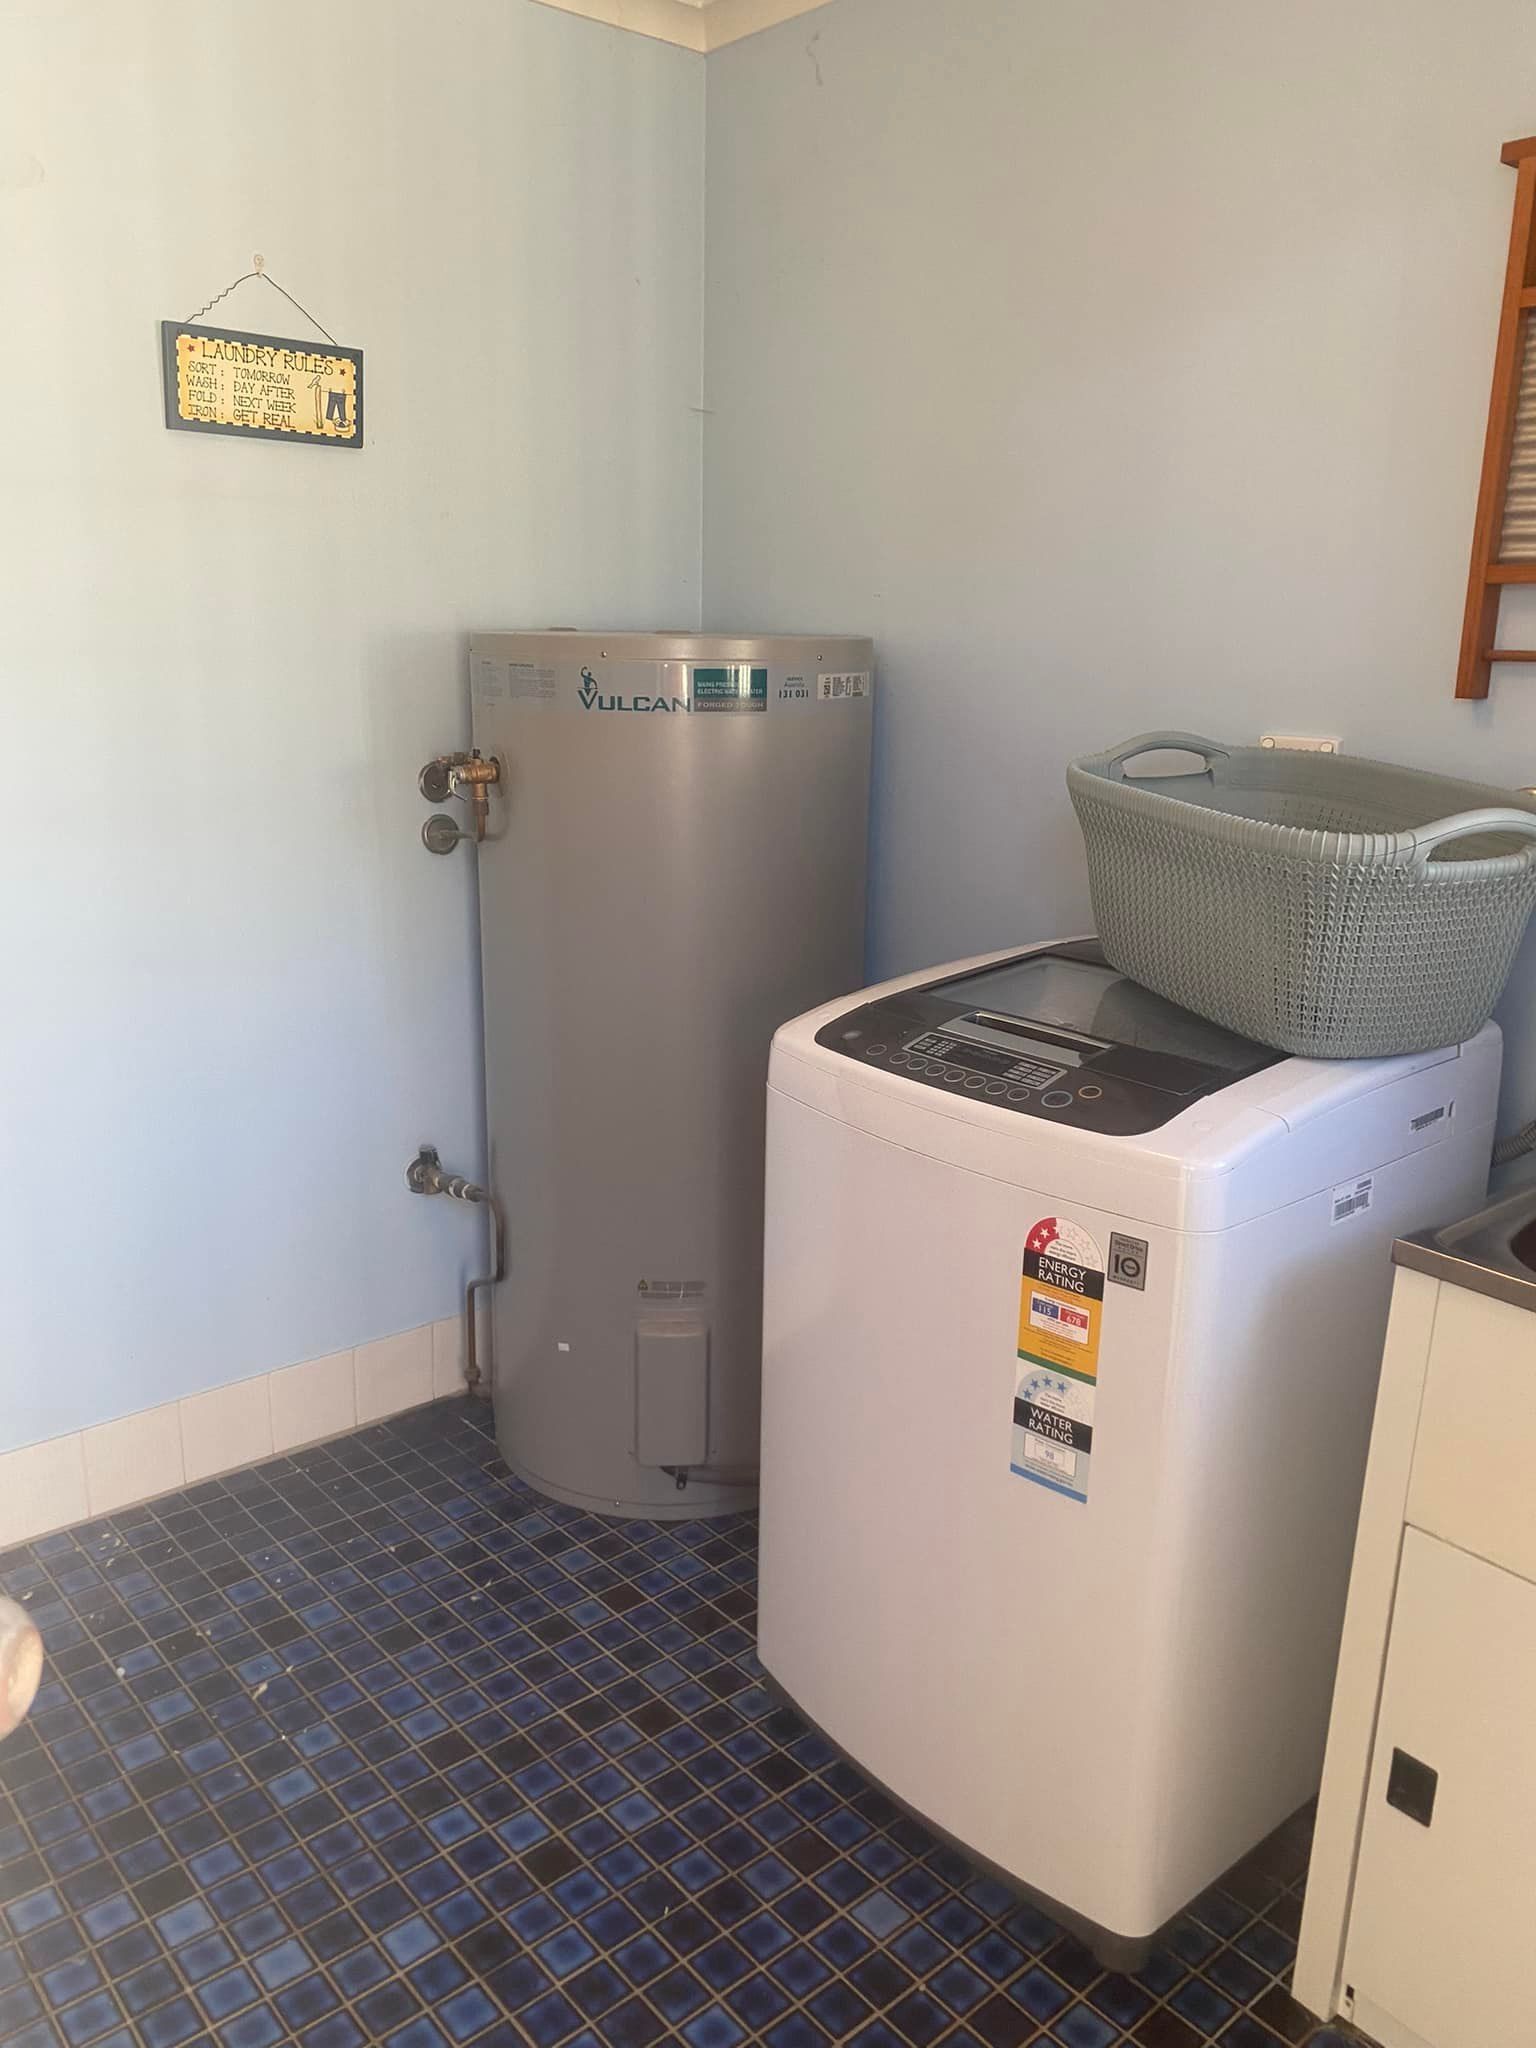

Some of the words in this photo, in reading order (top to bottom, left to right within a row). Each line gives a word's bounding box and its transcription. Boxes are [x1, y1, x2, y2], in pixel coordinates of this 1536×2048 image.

[202, 341, 277, 367] LAUNDRY
[284, 353, 334, 376] RULES
[233, 366, 290, 385] TOMORROW
[234, 381, 255, 394] DAY
[260, 384, 296, 400] AFTER
[234, 395, 263, 409] NEXT
[267, 399, 296, 414] WEEK
[233, 408, 258, 424] GET
[263, 412, 296, 428] REAL
[577, 690, 691, 712] VULCAN
[779, 689, 793, 699] 131
[795, 689, 809, 698] 031
[1039, 1256, 1087, 1281] ENERGY
[1114, 1254, 1140, 1278] 10
[1038, 1268, 1085, 1293] RATING
[1028, 1418, 1073, 1444] RATING
[1031, 1406, 1073, 1433] WATER
